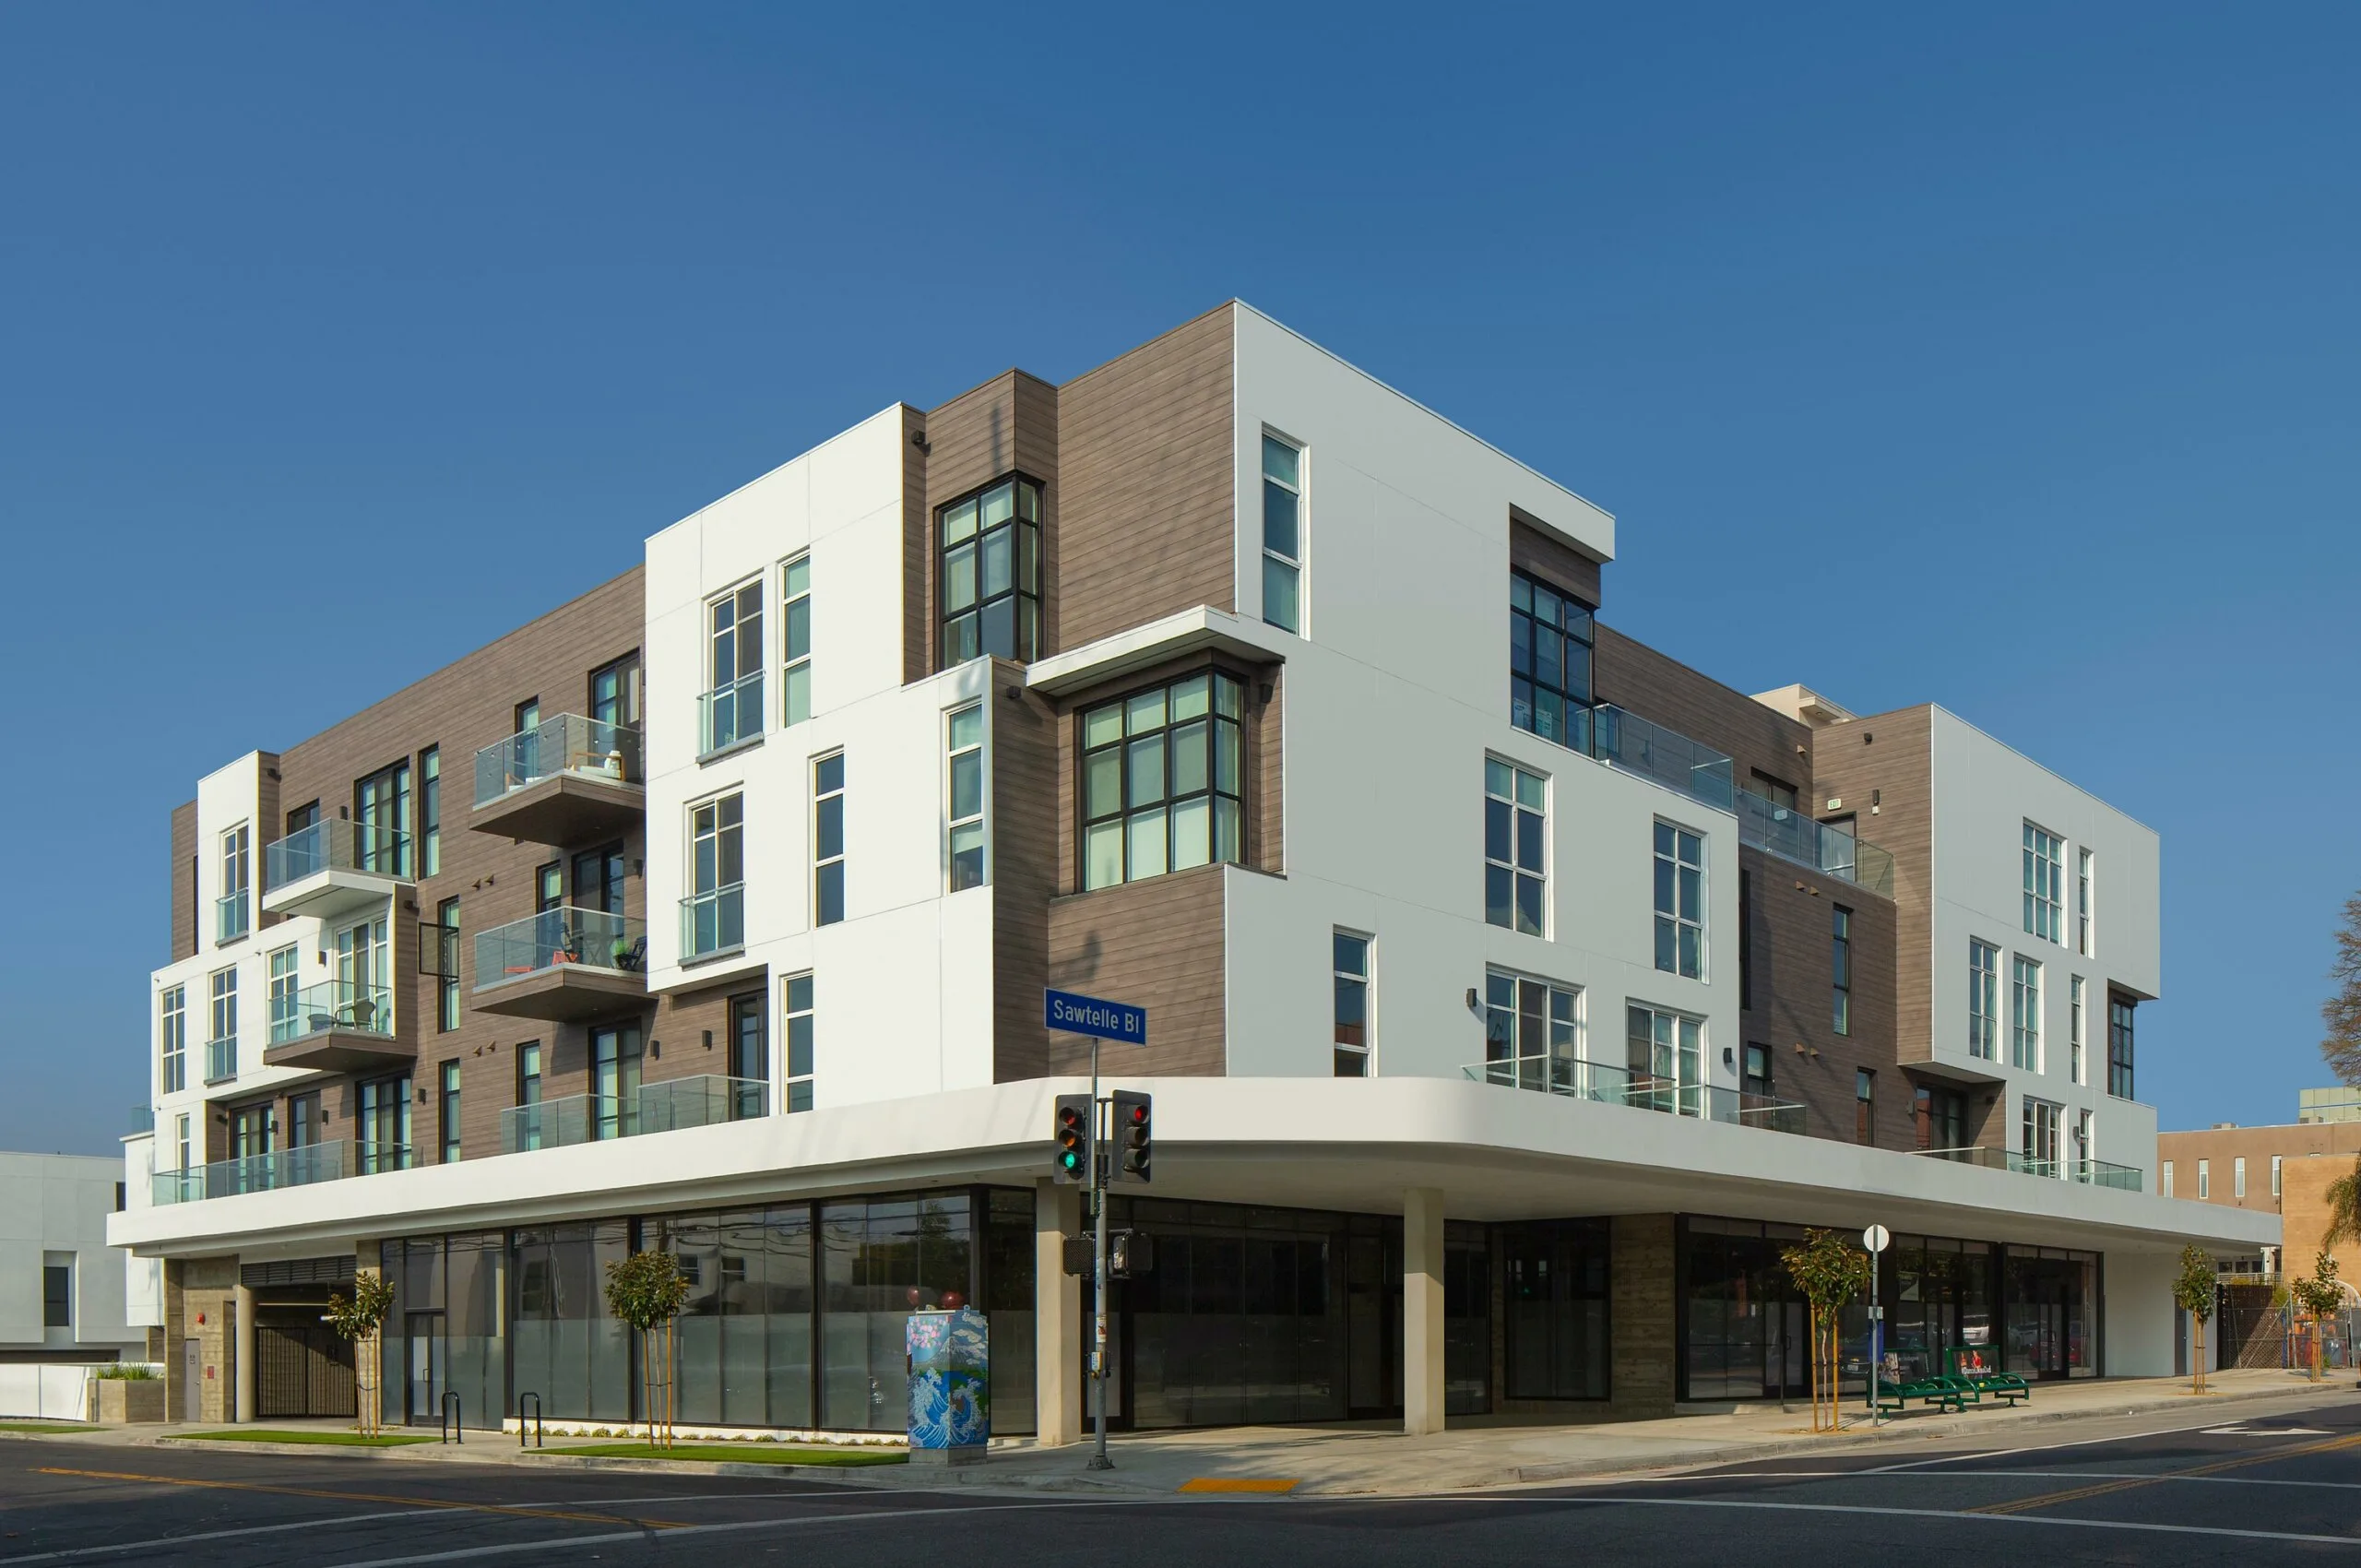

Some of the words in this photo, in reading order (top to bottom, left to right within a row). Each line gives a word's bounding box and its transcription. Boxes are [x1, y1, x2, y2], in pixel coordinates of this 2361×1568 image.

[1830, 800, 1840, 808] EXIT
[1054, 1000, 1119, 1029] Sawtelle
[1124, 1013, 1139, 1034] Bl
